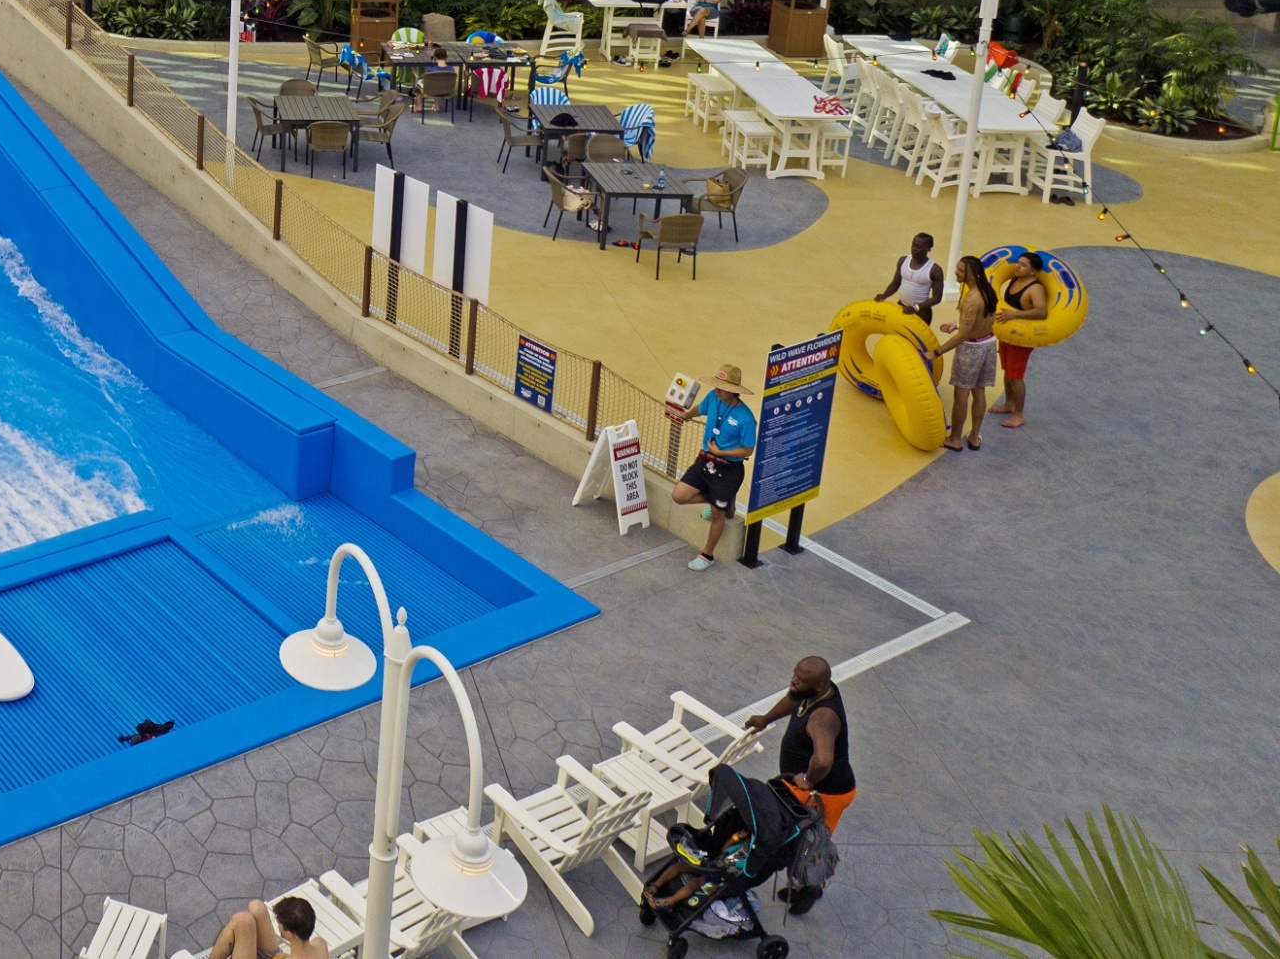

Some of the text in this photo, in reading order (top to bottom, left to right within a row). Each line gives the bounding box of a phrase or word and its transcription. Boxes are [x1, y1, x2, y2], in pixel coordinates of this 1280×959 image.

[525, 342, 549, 357] ATTENTION
[769, 334, 841, 363] WILD WAVE FLOWRIDER
[781, 350, 827, 372] ATTENTION
[619, 460, 638, 473] DO NOT
[621, 471, 639, 482] BLOCK
[625, 481, 638, 492] THIS
[626, 491, 640, 502] AREA
